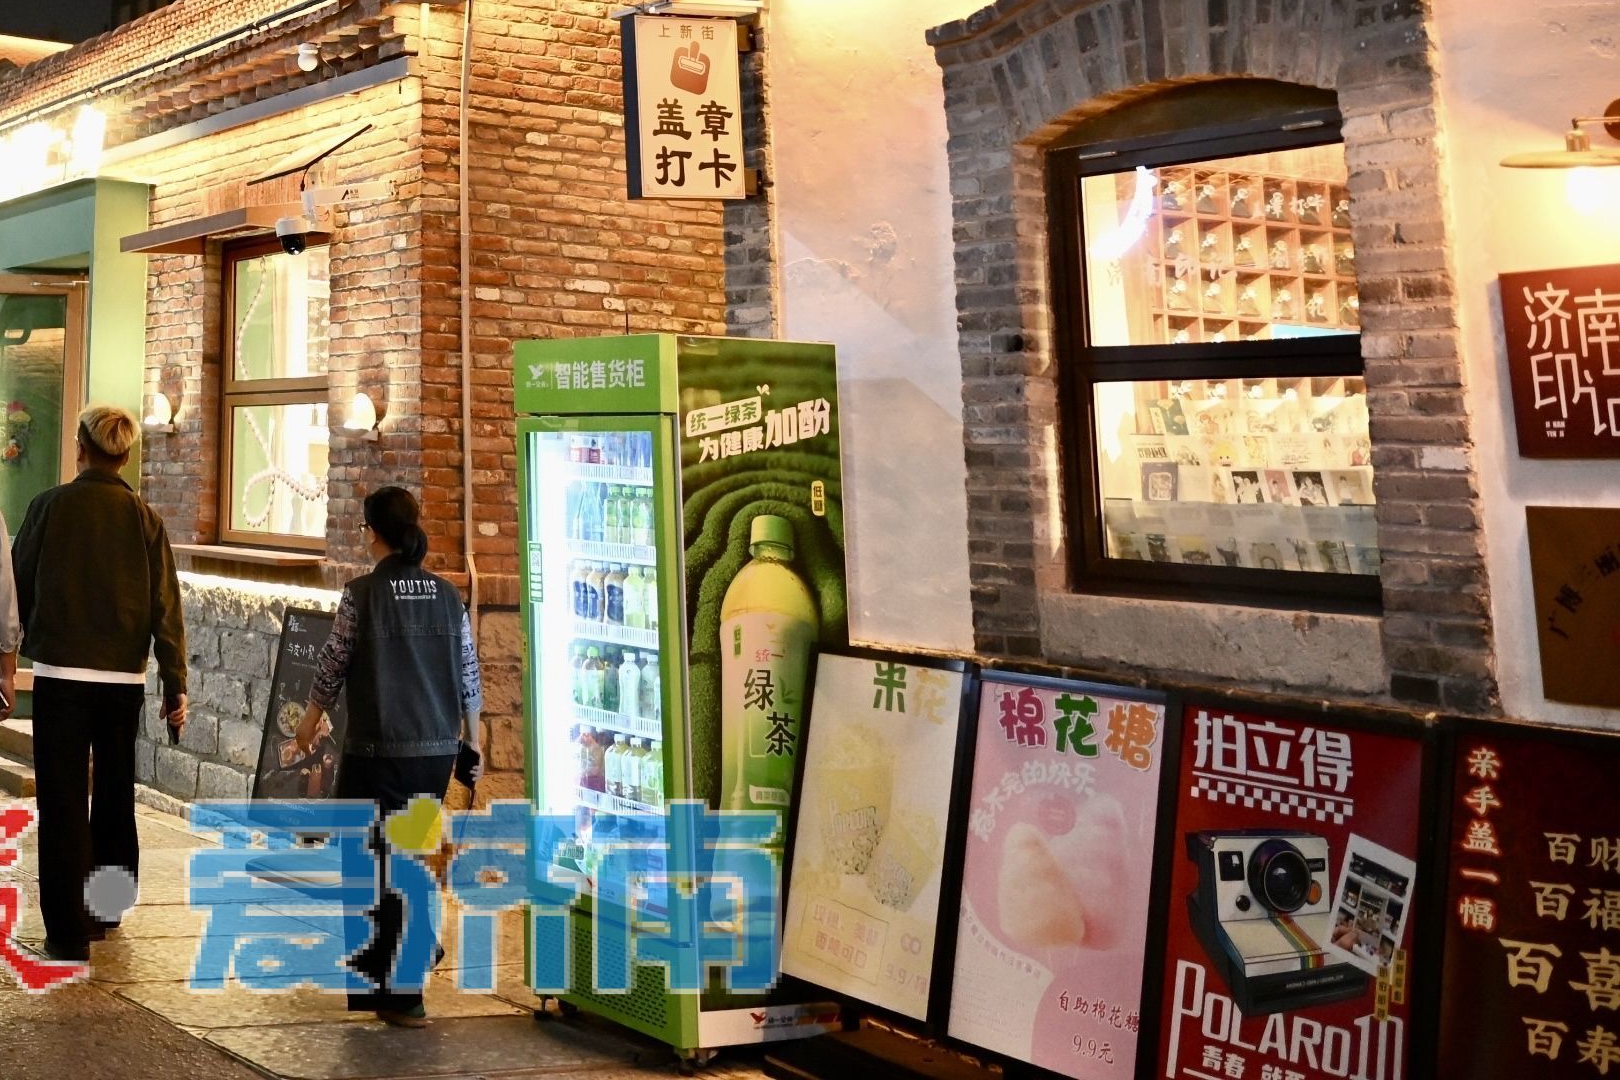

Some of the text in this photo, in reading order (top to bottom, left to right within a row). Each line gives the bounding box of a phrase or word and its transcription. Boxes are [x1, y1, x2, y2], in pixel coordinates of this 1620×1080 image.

[658, 23, 715, 41] 上新街
[652, 97, 733, 142] 盖章
[654, 145, 737, 189] 打卡
[1523, 282, 1620, 376] 济南
[555, 358, 646, 390] 智能售货柜
[690, 401, 758, 433] 统一绿茶
[743, 668, 797, 757] 绿茶
[998, 686, 1158, 772] 棉花糖
[1192, 710, 1355, 794] 拍立得
[1458, 746, 1502, 933] 亲手盖一幅
[1539, 831, 1620, 873] 百财
[1528, 880, 1620, 933] 百福
[1497, 936, 1620, 1013] 百喜
[1058, 990, 1140, 1034] 自助棉花糖
[1073, 1033, 1114, 1065] 9.9元
[1202, 1043, 1246, 1080] 青春
[1520, 1016, 1620, 1076] 百寿
